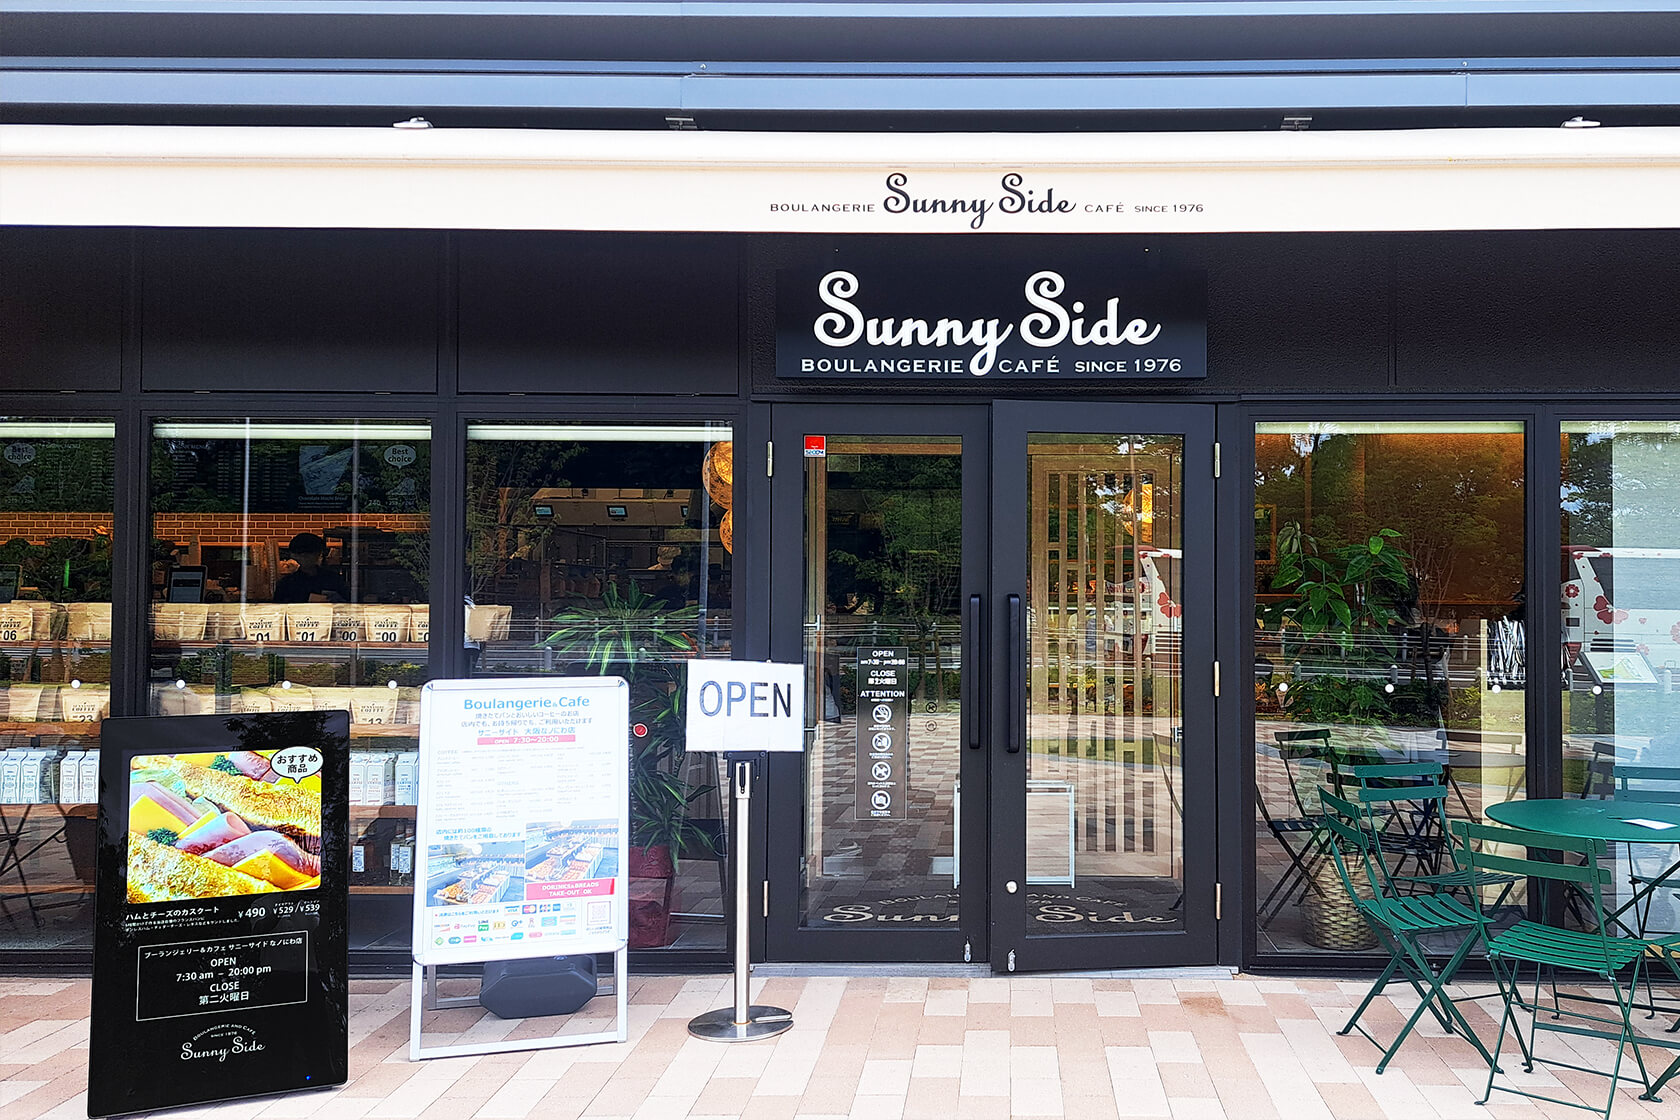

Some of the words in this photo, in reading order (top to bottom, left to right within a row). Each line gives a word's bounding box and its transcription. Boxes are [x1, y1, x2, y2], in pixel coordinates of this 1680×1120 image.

[770, 203, 876, 213] BOULANGERIE
[883, 172, 994, 230] Sunny
[998, 172, 1077, 214] Side
[1084, 202, 1125, 213] CAFÉ
[1134, 205, 1169, 213] SINCE
[1172, 203, 1205, 213] 1976
[813, 270, 1014, 377] Sunny
[1019, 270, 1162, 348] Side
[801, 358, 964, 374] BOULANGERIE
[998, 355, 1061, 374] CAFÉ
[1074, 359, 1128, 373] SINCE
[1133, 358, 1183, 373] 1976
[387, 455, 412, 464] choice
[256, 632, 270, 641] 01
[301, 631, 315, 641] 01
[342, 631, 357, 641] 00
[382, 632, 397, 642] 00
[699, 680, 791, 718] OPEN
[860, 690, 905, 698] ATTENTION
[463, 697, 552, 711] Boulangerie
[558, 696, 590, 708] Cafe
[276, 753, 318, 764] おすすめ
[287, 763, 308, 774] 商品
[125, 906, 220, 921] ハムとチーズのカスクート
[1035, 904, 1178, 923] Side
[210, 956, 237, 967] OPEN
[176, 971, 197, 982] 7:30
[198, 972, 214, 980] am
[228, 966, 255, 977] 20:00
[256, 965, 272, 976] pm
[209, 981, 240, 992] CLOSE
[199, 990, 250, 1005] 第二火曜日
[180, 1041, 231, 1062] Sunny
[231, 1036, 266, 1055] Side
